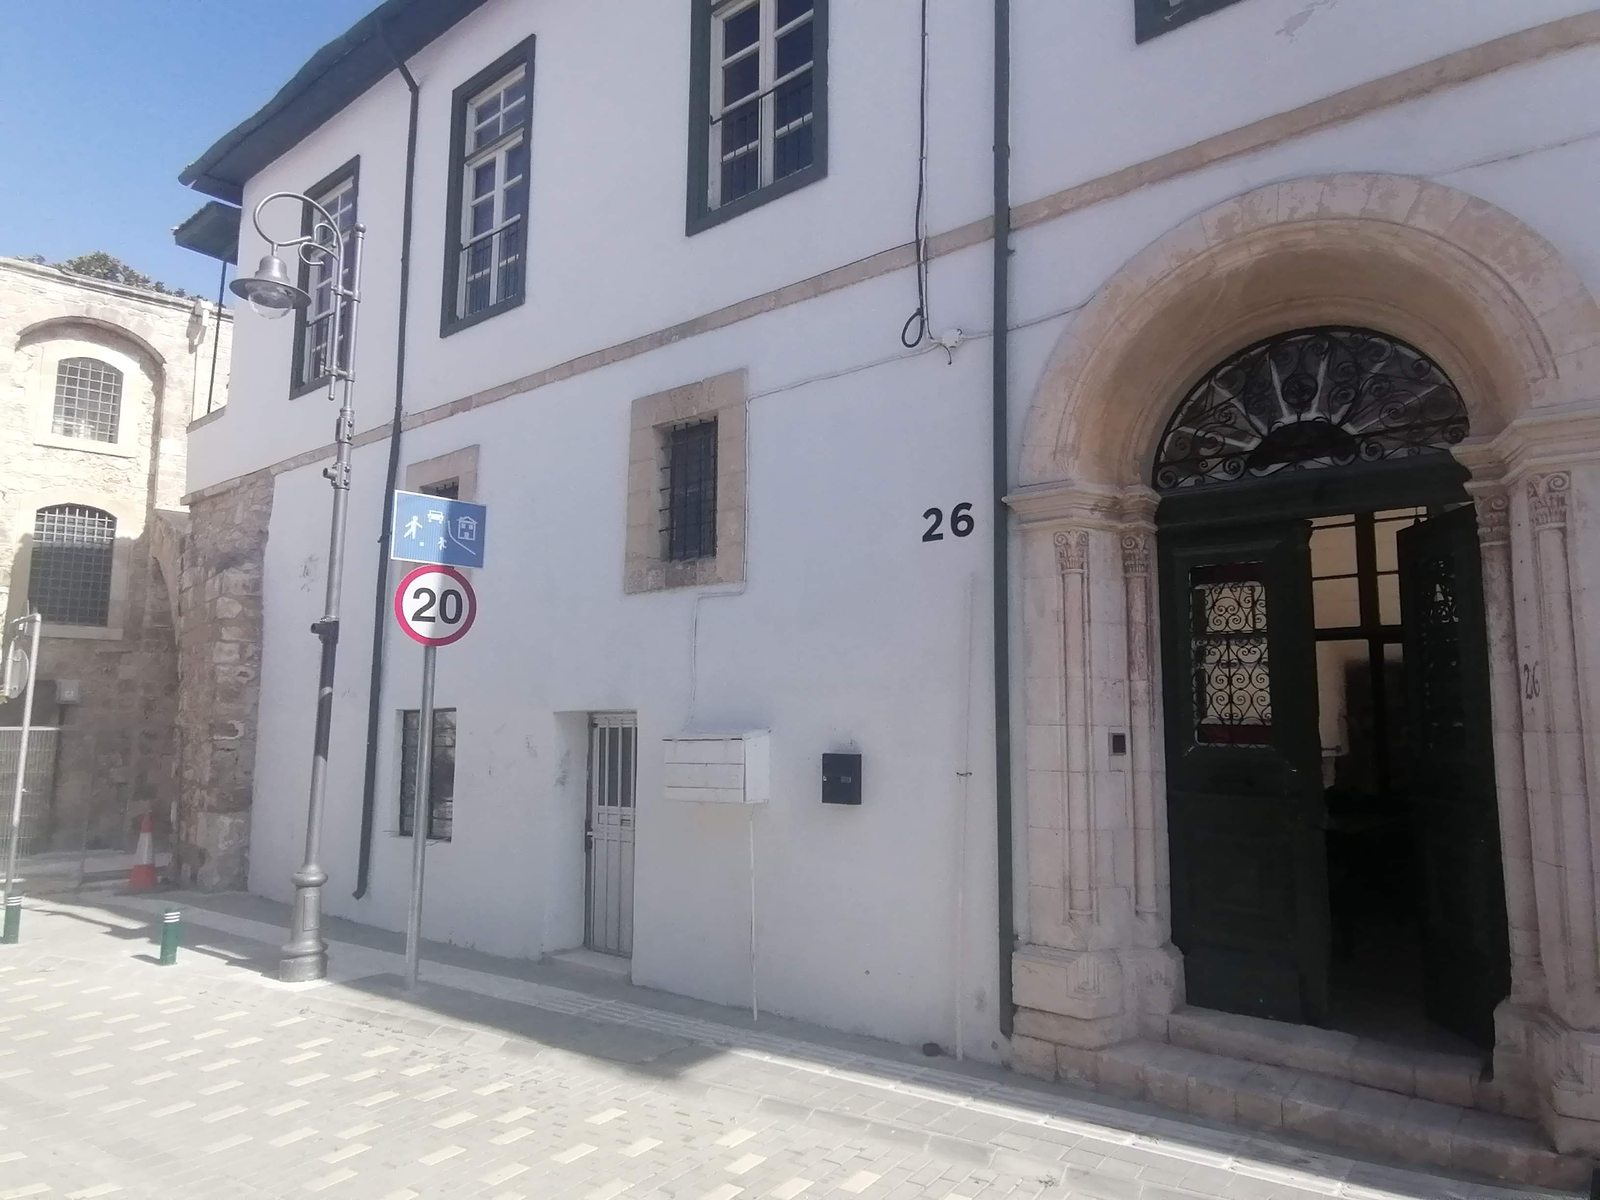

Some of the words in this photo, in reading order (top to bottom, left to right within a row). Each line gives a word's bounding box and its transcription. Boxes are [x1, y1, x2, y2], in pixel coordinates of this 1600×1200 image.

[922, 502, 974, 542] 26
[412, 587, 462, 624] 20
[1523, 661, 1540, 700] 26
